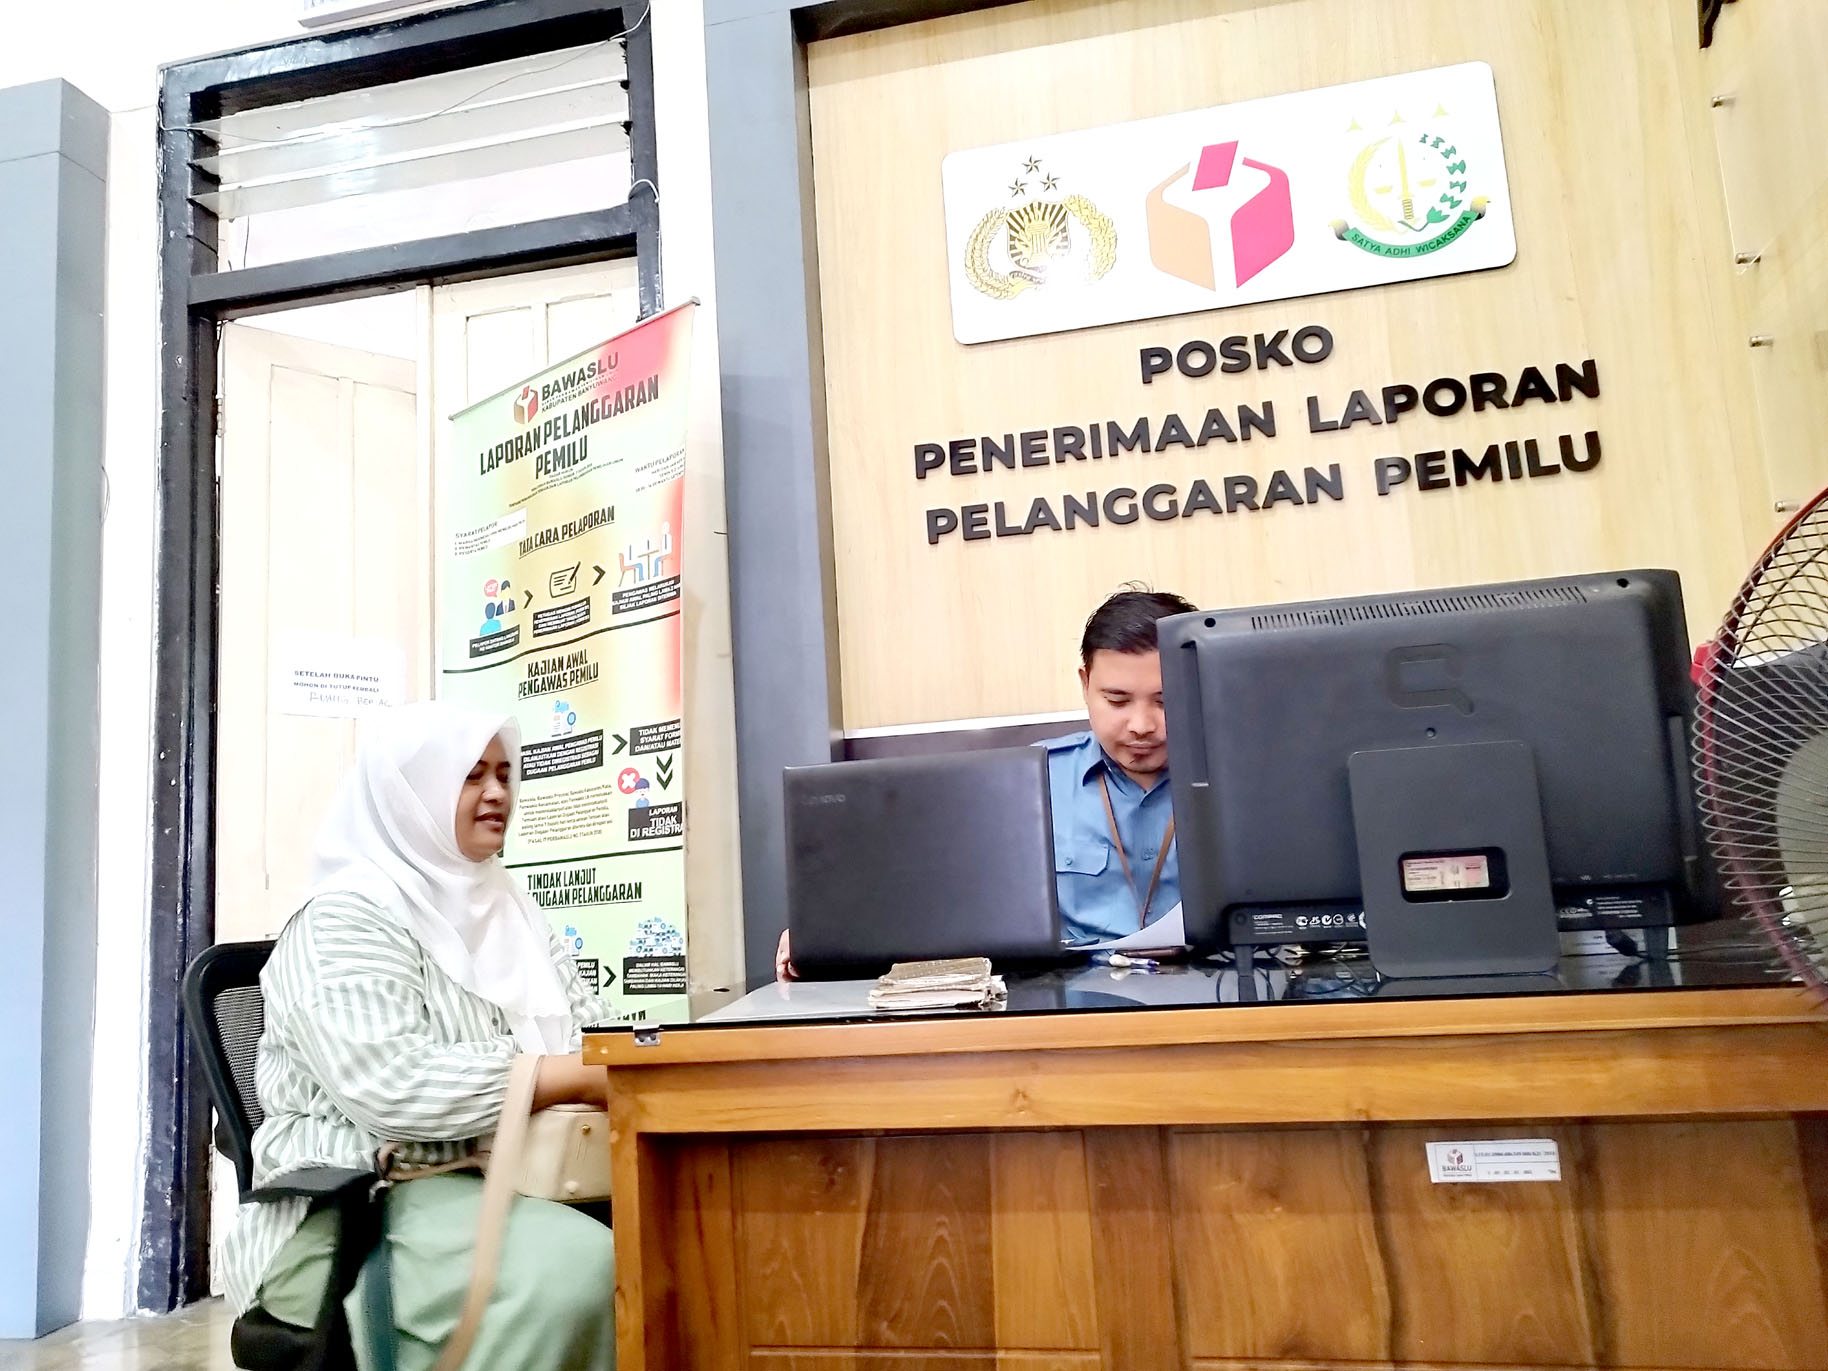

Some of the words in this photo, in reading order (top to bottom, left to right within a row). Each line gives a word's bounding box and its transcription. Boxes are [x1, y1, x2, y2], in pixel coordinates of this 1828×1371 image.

[1352, 233, 1381, 253] SATYA
[1385, 247, 1411, 256] ADHI
[1416, 215, 1471, 253] WICAKSANA
[1140, 325, 1333, 384] POSKO
[542, 352, 618, 401] BAWASLU
[480, 425, 540, 476] LAPORAN
[543, 374, 659, 446] PELANGGARAN
[914, 401, 1277, 479] PENERIMAAN
[1307, 359, 1600, 433] LAPORAN
[536, 435, 588, 480] PEMILU
[926, 463, 1344, 544] PELANGGARAN
[1375, 430, 1602, 496] PEMILU
[519, 536, 533, 556] TATA
[535, 526, 558, 549] CARA
[561, 505, 615, 540] PELAPORAN
[294, 670, 331, 678] SETELAH
[333, 672, 355, 680] BUKA
[518, 673, 568, 698] PENGAWAS
[569, 661, 599, 688] PEMILU
[528, 656, 564, 678] KAJIAN
[566, 648, 588, 672] AWAL
[649, 806, 678, 816] LAPORAN
[650, 815, 677, 828] TIDAK
[630, 828, 640, 839] DI
[528, 871, 561, 890] TINDAK
[563, 867, 596, 887] LANJUT
[572, 882, 642, 904] PELANGGARAN
